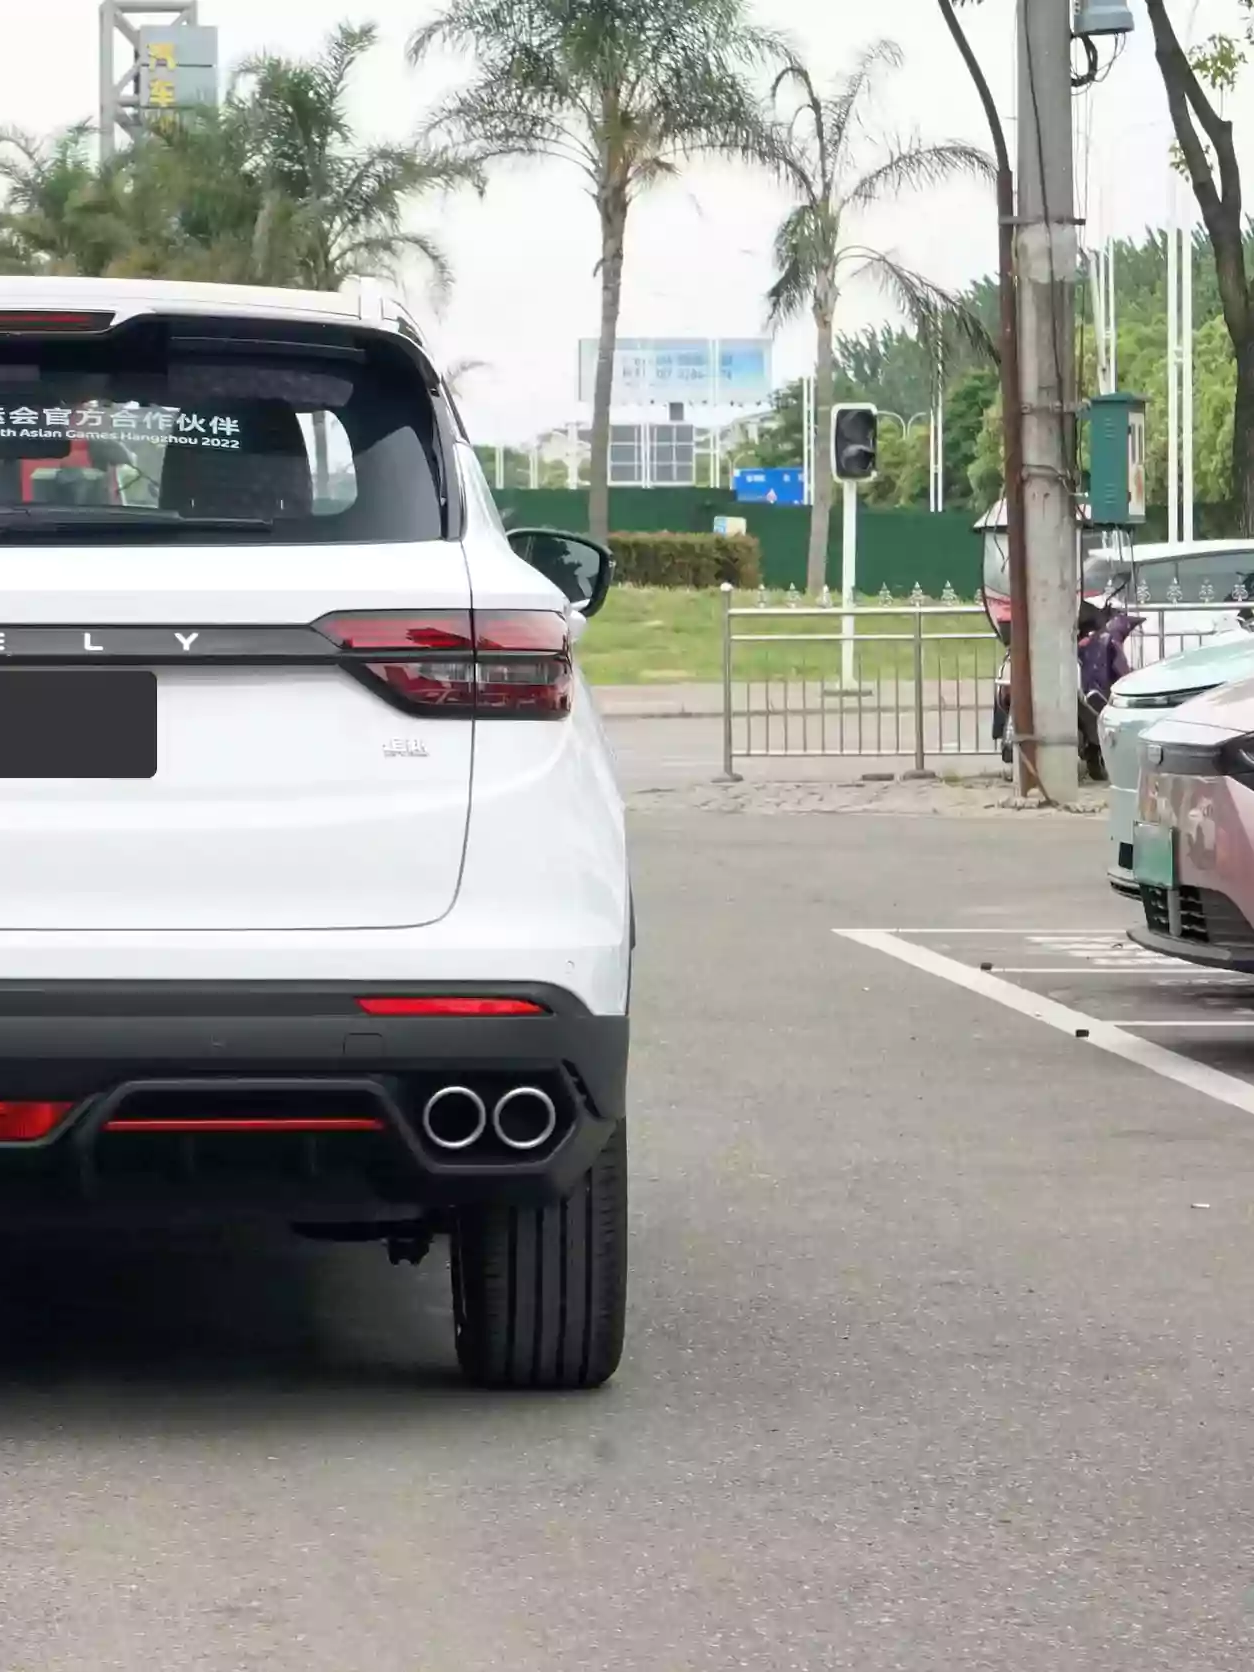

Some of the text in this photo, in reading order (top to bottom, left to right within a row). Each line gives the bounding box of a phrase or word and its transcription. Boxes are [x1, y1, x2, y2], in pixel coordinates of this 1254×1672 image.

[20, 428, 62, 438] Asian
[66, 429, 118, 440] Games
[120, 432, 198, 446] Hangzhou
[201, 436, 241, 448] 2022
